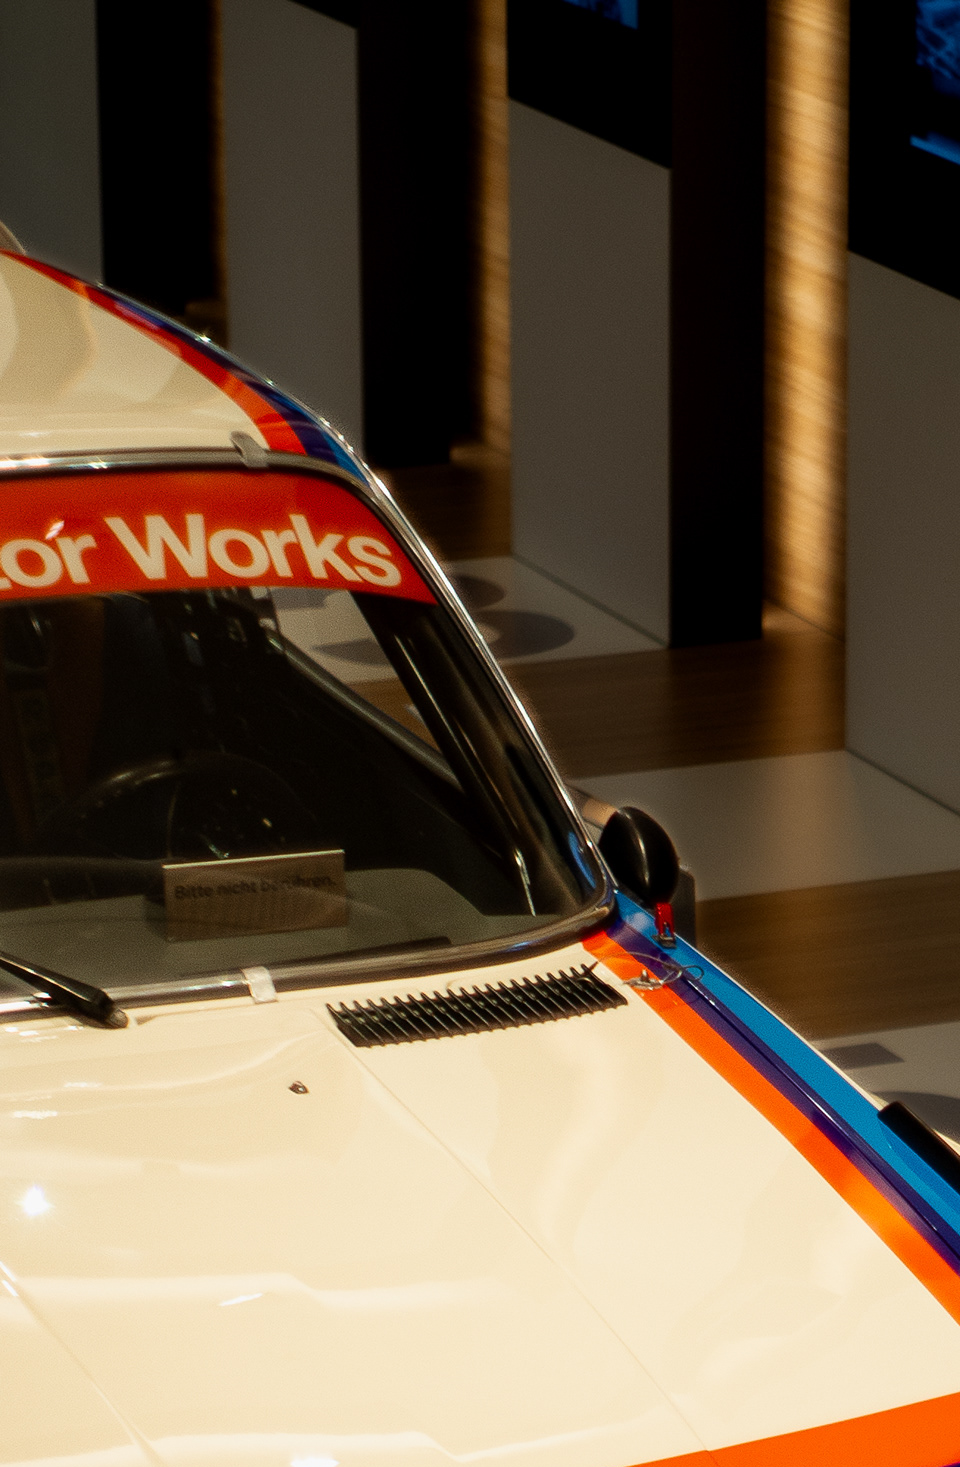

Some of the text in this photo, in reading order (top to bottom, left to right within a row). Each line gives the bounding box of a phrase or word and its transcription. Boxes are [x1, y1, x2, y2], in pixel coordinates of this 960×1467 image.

[0, 512, 402, 591] or Works
[174, 884, 213, 899] Bitte
[217, 881, 257, 896] nicht
